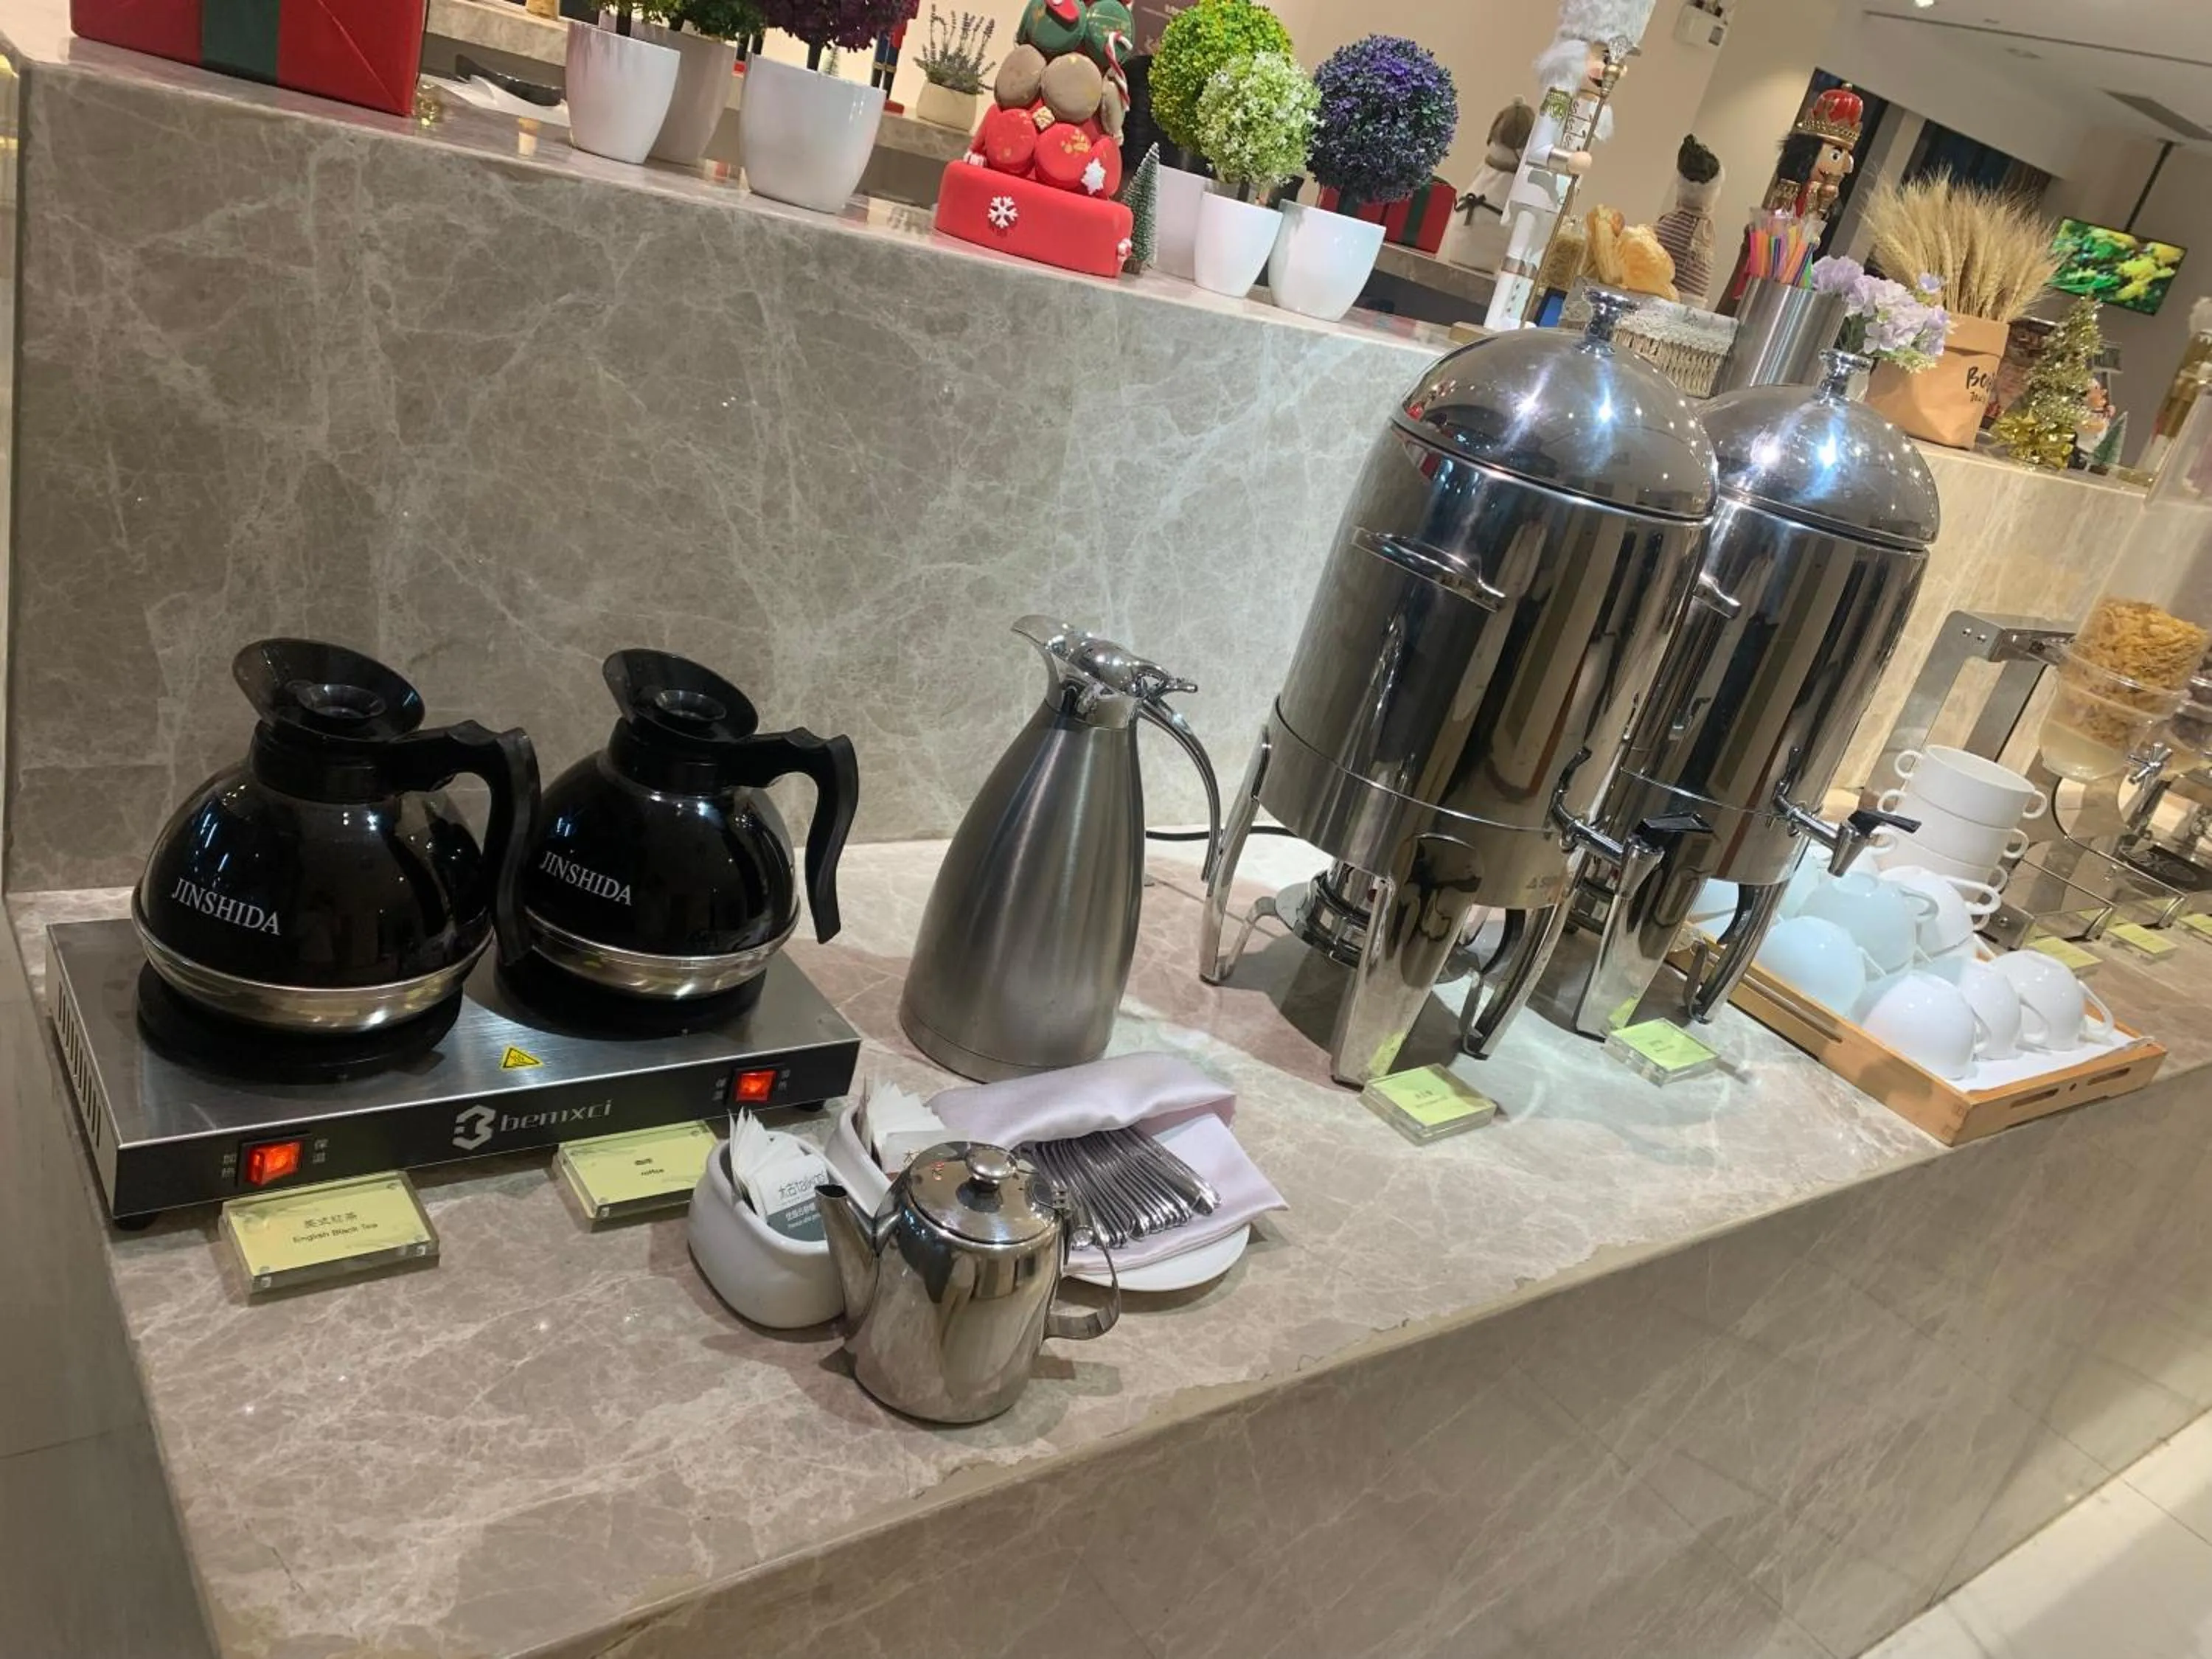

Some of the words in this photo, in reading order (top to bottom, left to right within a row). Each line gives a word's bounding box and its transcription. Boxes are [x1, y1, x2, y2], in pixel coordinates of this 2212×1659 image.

[539, 850, 632, 906] JINSHIDA
[171, 877, 281, 936] JINSHIDA
[292, 1232, 330, 1243] English
